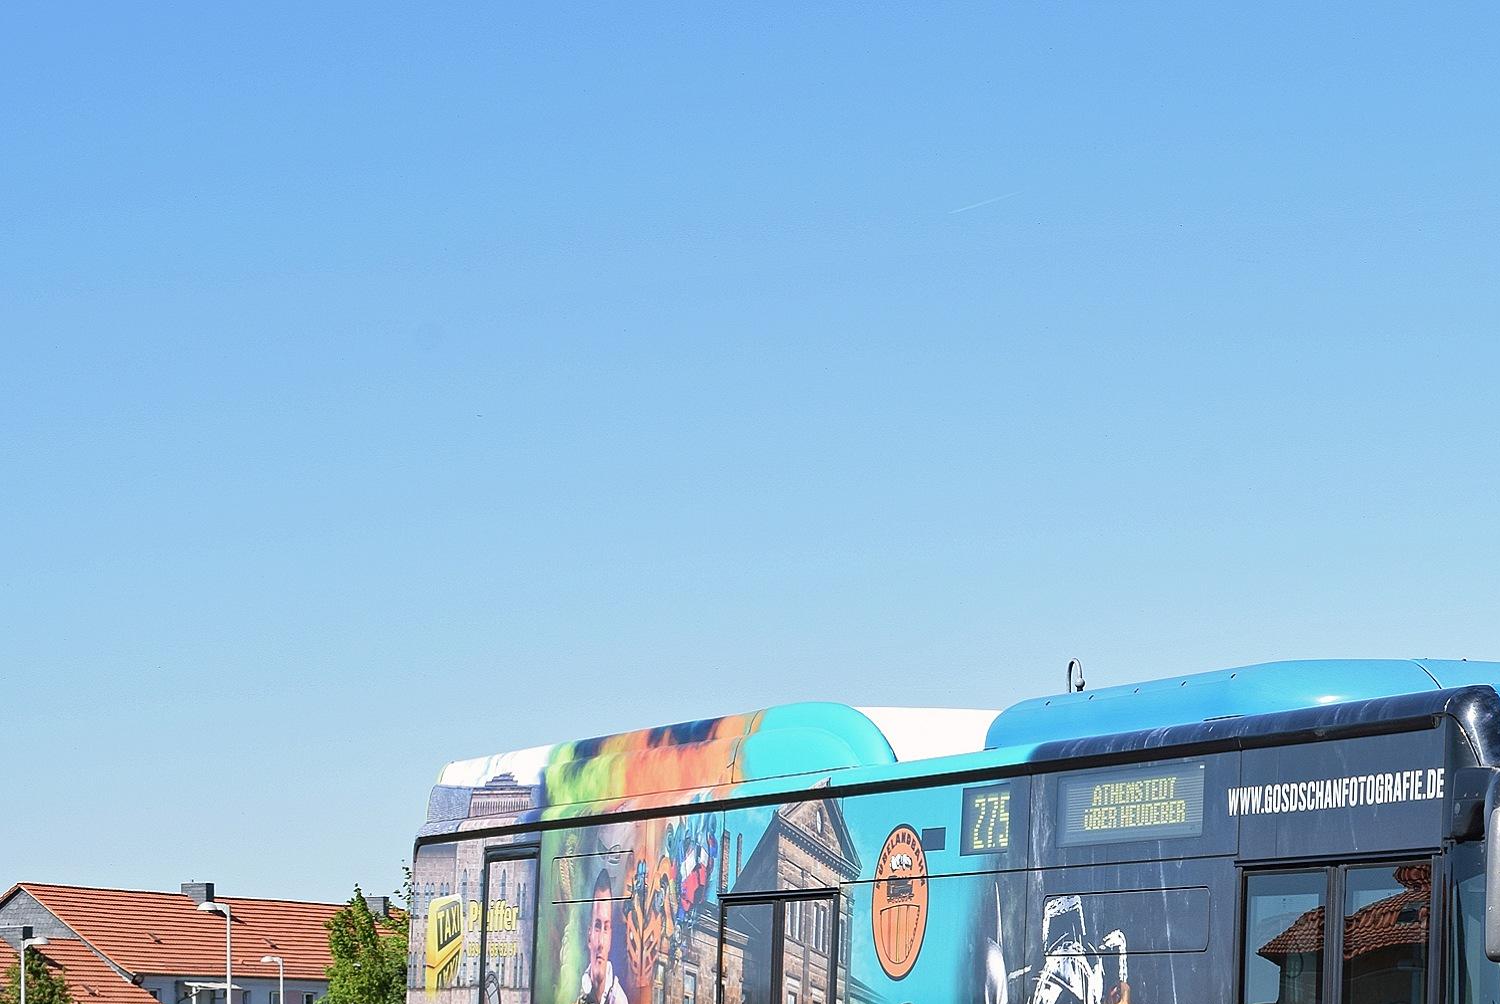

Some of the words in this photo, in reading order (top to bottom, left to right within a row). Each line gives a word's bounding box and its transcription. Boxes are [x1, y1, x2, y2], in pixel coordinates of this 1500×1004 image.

[1092, 777, 1177, 807] ATHENSTEDT
[1228, 767, 1446, 817] WWW.GOSDSCHANFOTOGRAFIE.DE
[972, 792, 1011, 850] 275
[1119, 800, 1186, 828] HEUDEBER
[437, 903, 460, 946] TAXI
[467, 898, 520, 933] Pfiffer
